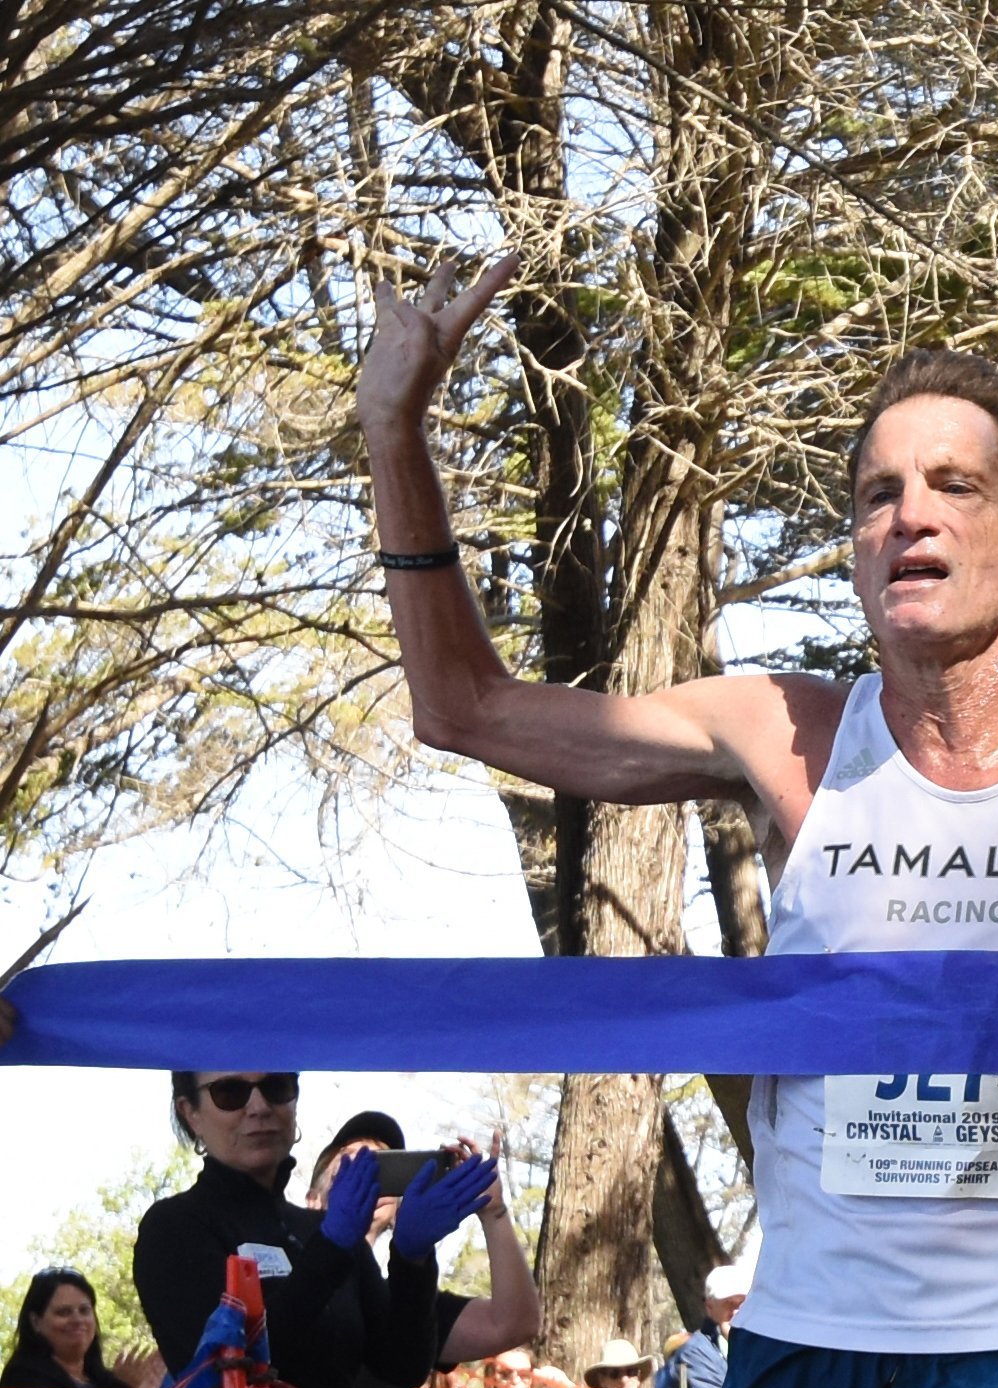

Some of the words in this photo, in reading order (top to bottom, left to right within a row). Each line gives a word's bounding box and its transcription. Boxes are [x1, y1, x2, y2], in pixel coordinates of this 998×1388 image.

[868, 1110, 956, 1124] Invitational
[846, 1122, 922, 1141] CRYSTAL
[900, 1160, 951, 1171] RUNNING
[956, 1161, 998, 1172] DIPSEA
[875, 1172, 940, 1183] SURVIVORS
[944, 1173, 990, 1184] T-SHIRT
